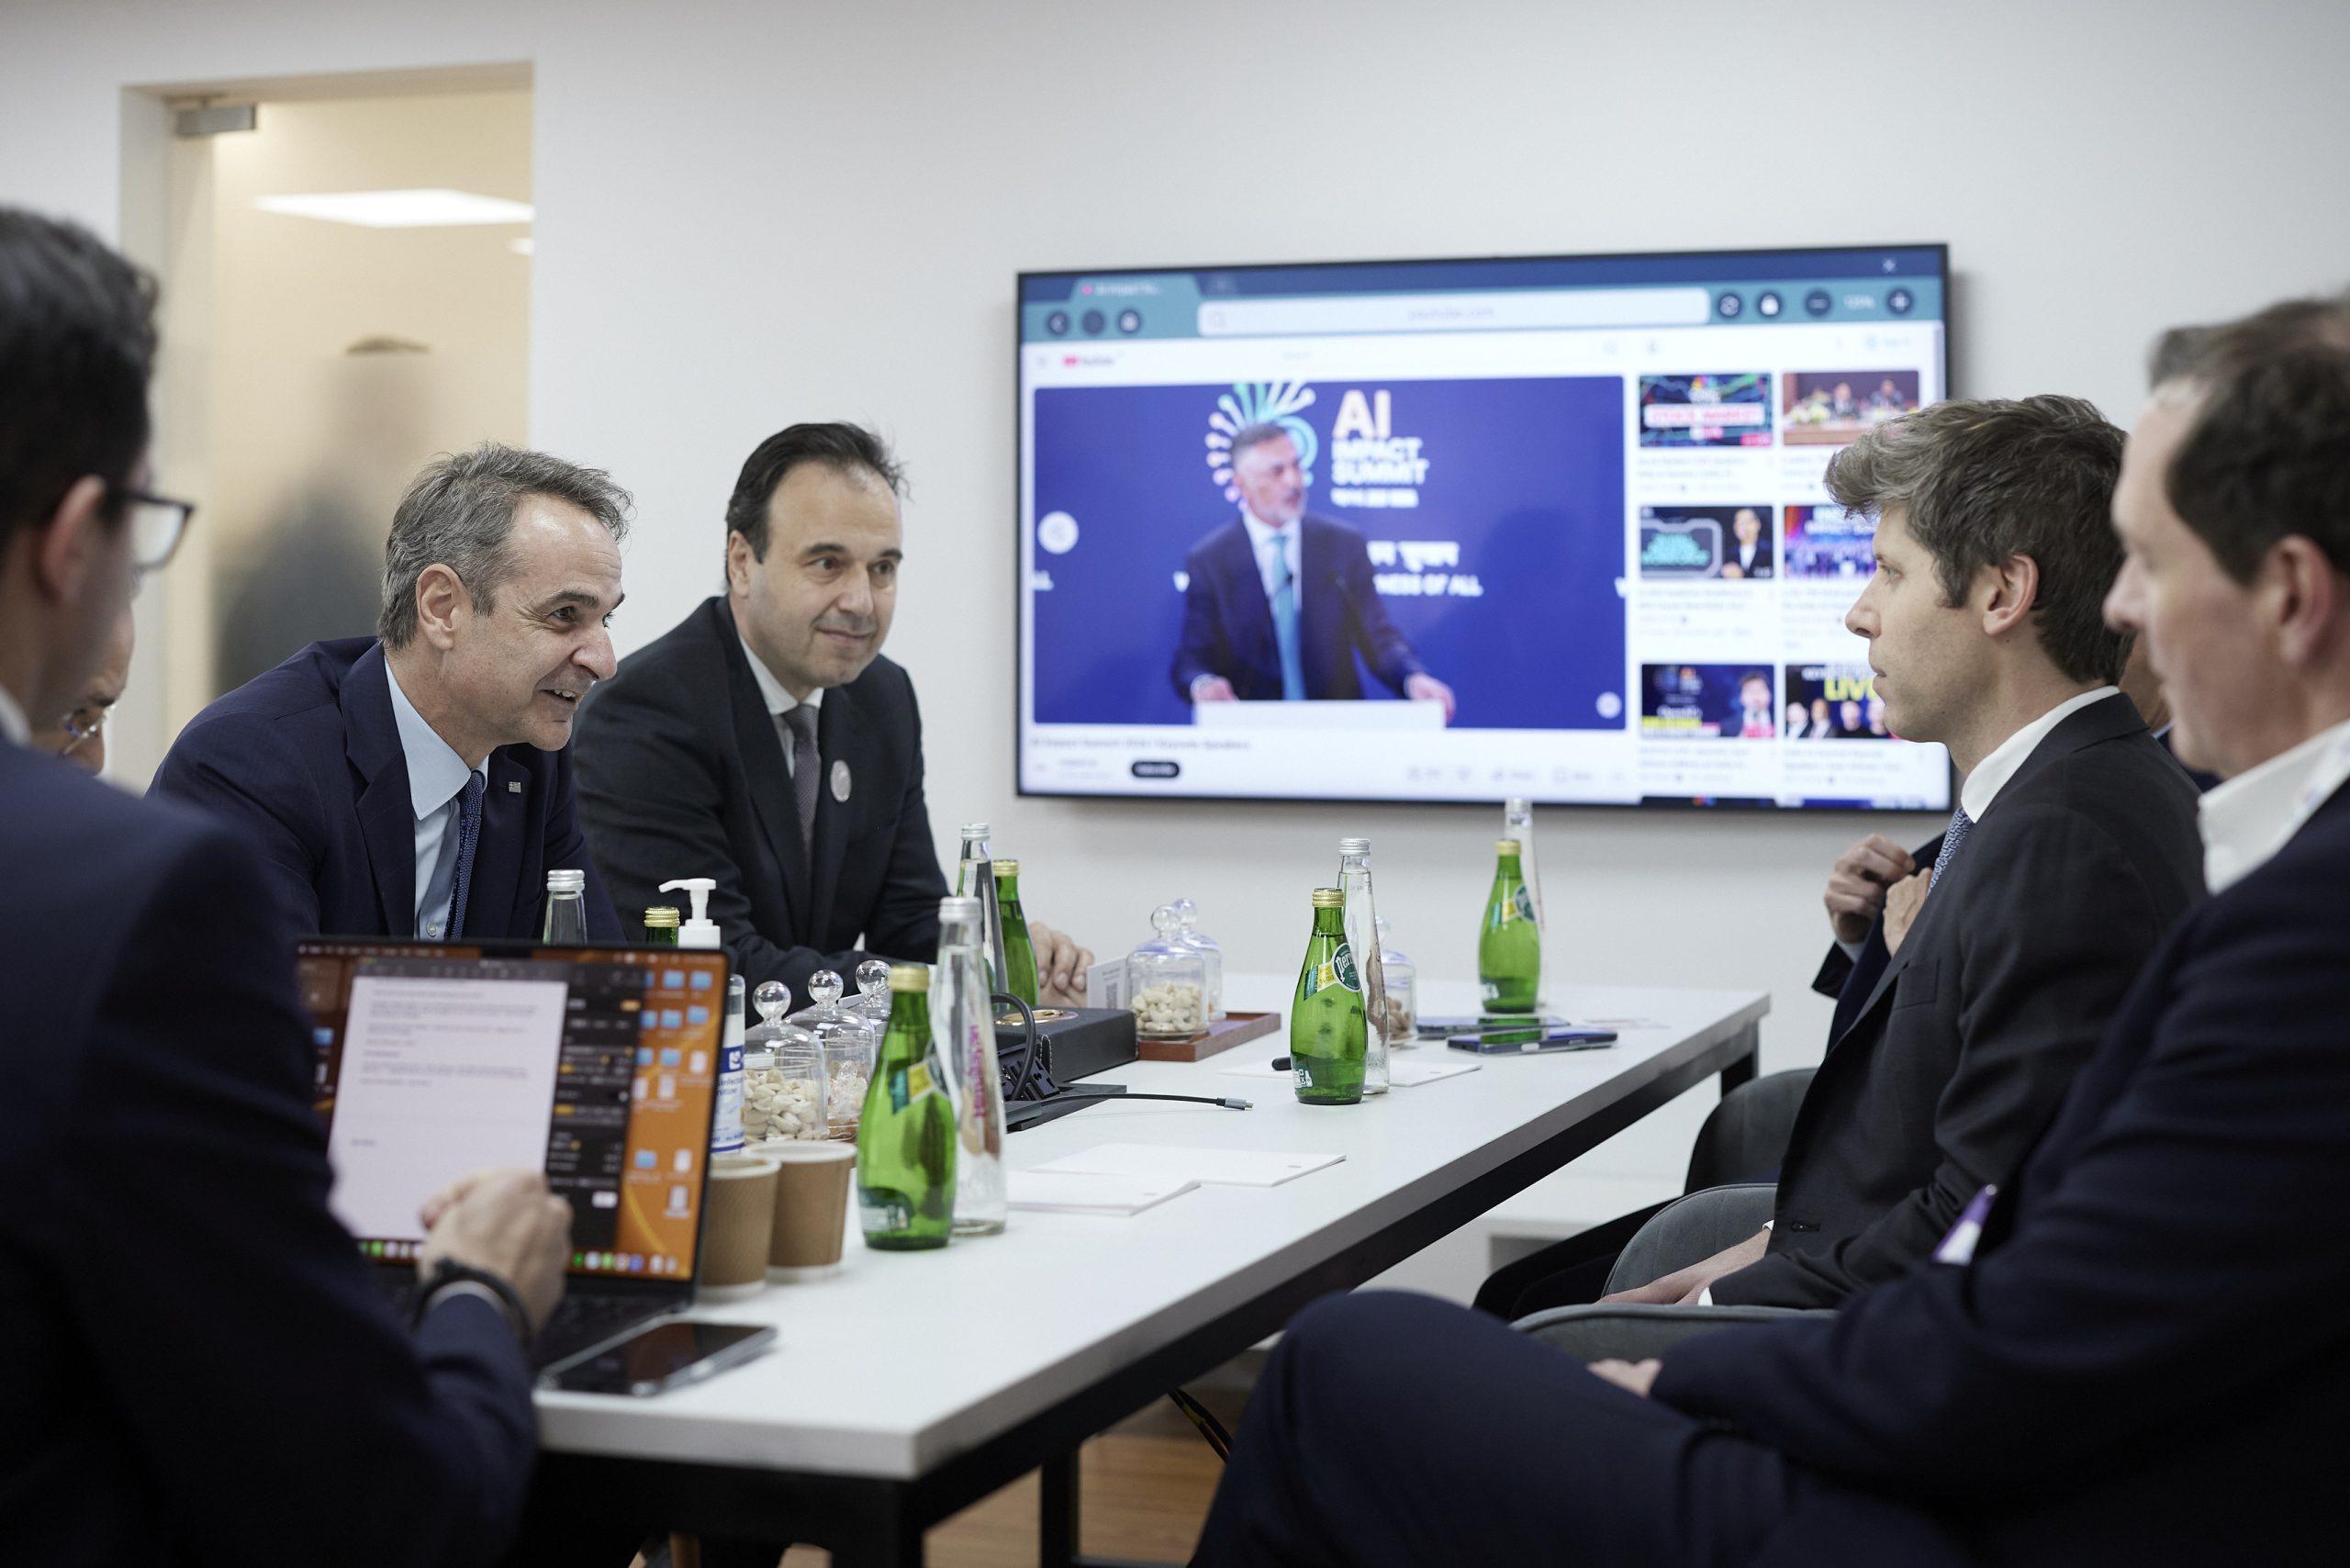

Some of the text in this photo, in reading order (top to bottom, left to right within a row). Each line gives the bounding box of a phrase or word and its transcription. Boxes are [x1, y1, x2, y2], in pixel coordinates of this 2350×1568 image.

[1332, 389, 1392, 439] AI
[1331, 437, 1424, 461] IMPACT
[1331, 458, 1430, 486] SUMMIT
[1423, 573, 1449, 597] OF
[1448, 574, 1484, 598] ALL
